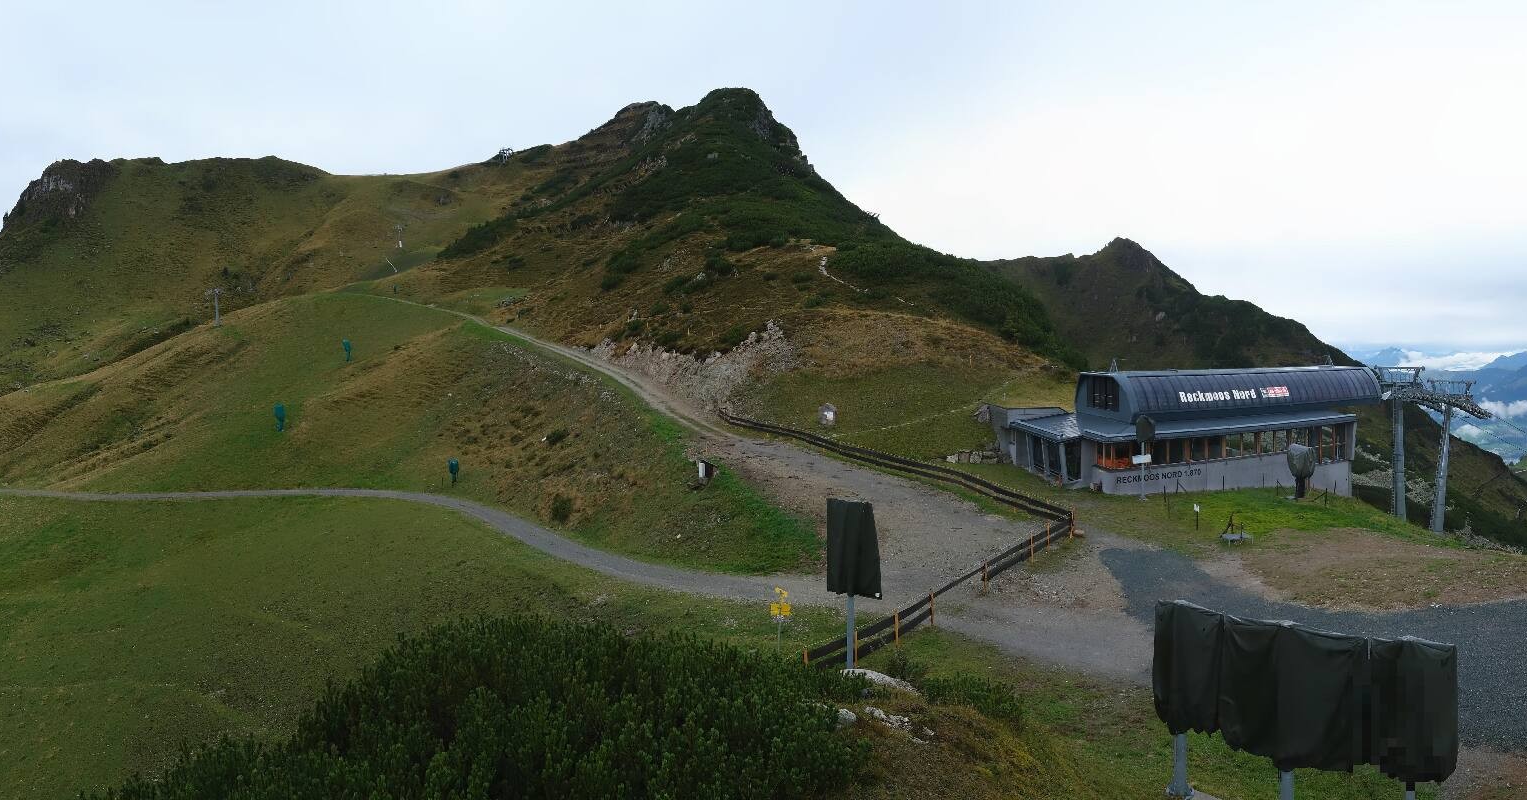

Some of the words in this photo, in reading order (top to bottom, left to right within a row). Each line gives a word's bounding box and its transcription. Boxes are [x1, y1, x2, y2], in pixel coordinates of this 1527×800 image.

[1178, 390, 1231, 403] Reckmoos
[1231, 388, 1257, 400] Nord
[1161, 470, 1182, 480] NORD
[1184, 468, 1202, 477] 1.870
